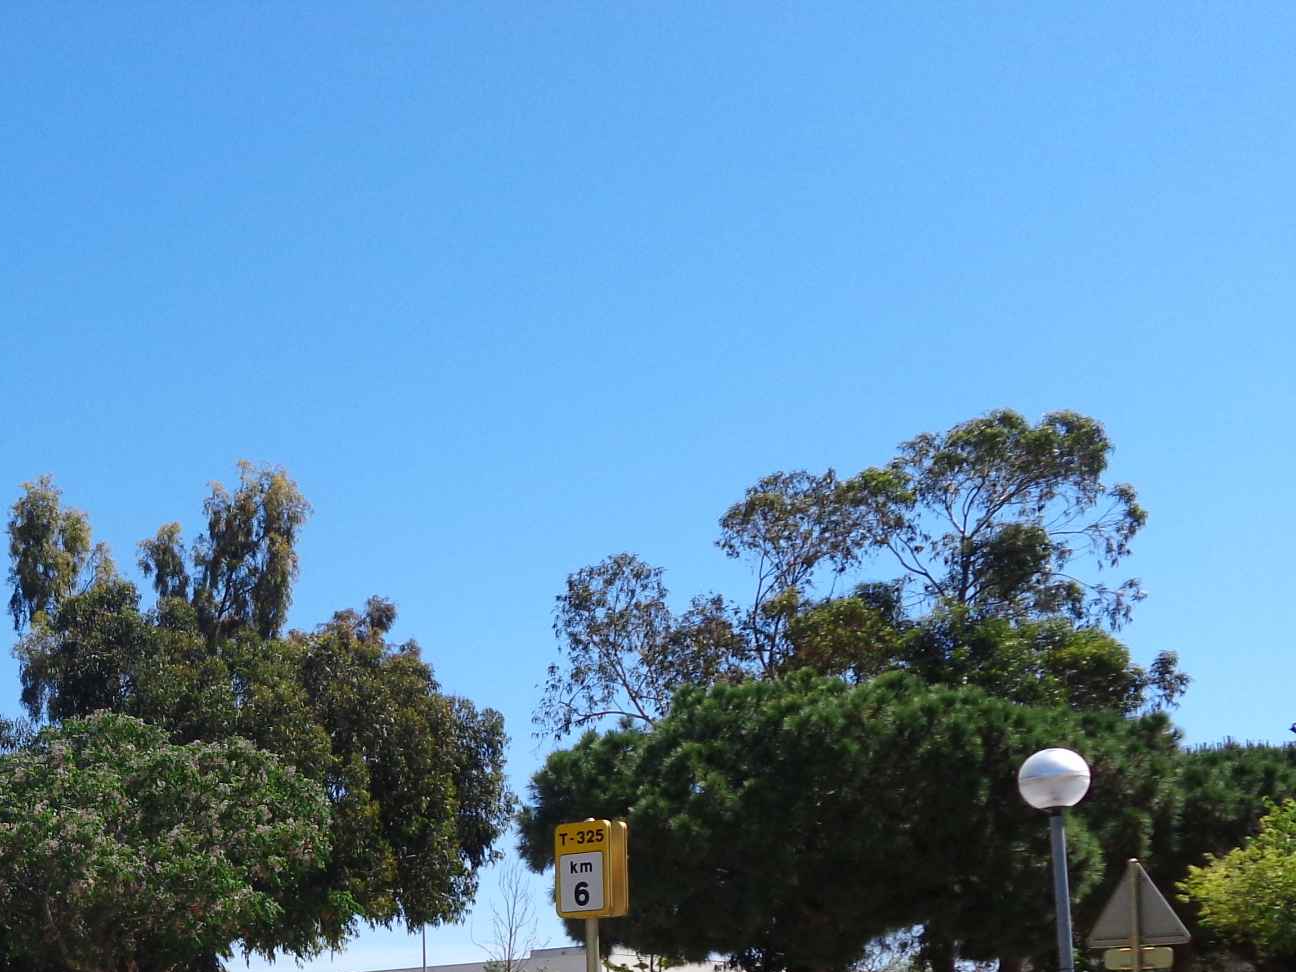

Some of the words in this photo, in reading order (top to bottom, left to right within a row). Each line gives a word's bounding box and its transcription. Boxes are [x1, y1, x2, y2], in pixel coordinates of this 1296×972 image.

[559, 829, 605, 846] T-325
[570, 861, 593, 873] km
[574, 881, 590, 906] 6
